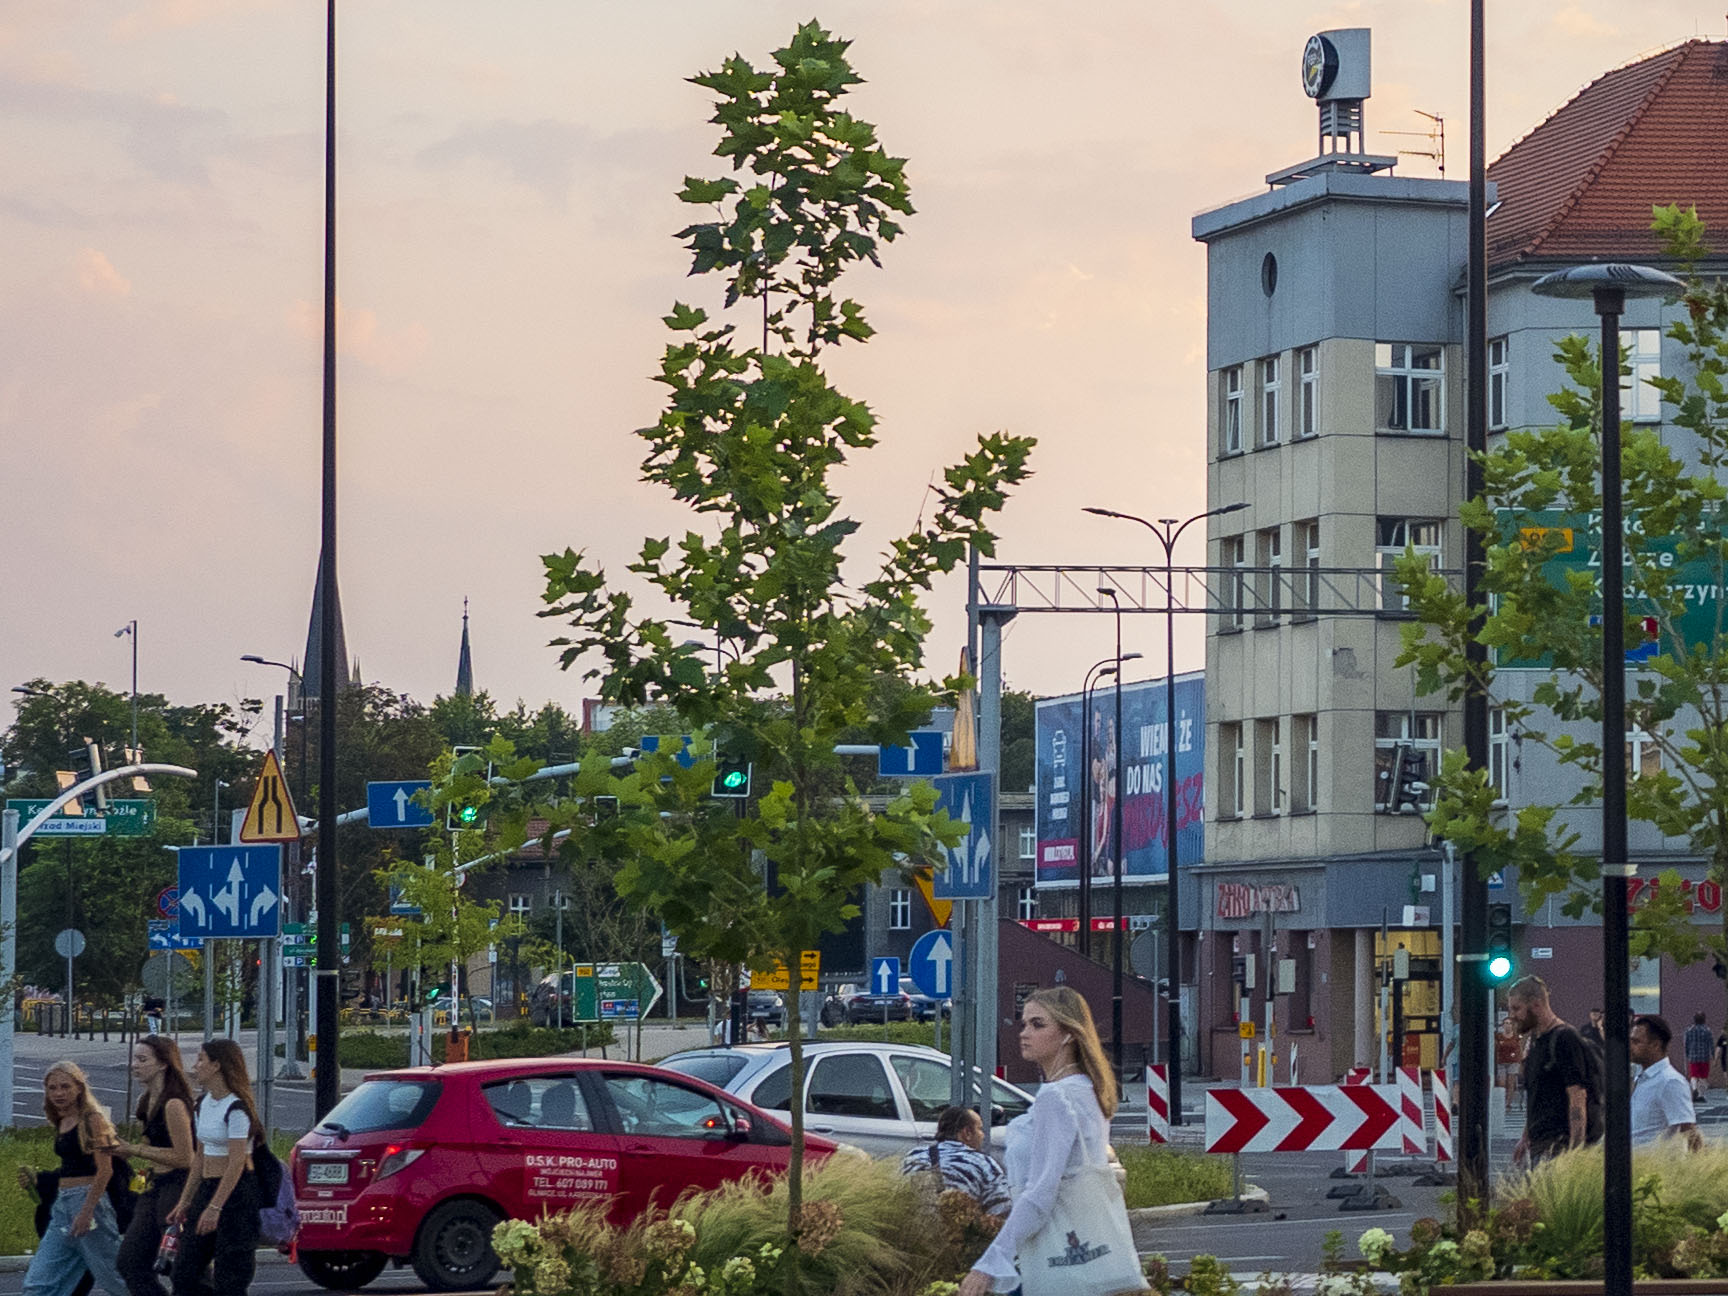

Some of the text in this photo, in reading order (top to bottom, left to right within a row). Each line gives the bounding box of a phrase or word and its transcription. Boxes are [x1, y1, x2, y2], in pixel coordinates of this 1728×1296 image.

[1178, 709, 1193, 753] ŻE
[1126, 762, 1163, 796] DO NAS
[558, 1156, 617, 1170] PRO-AUTO
